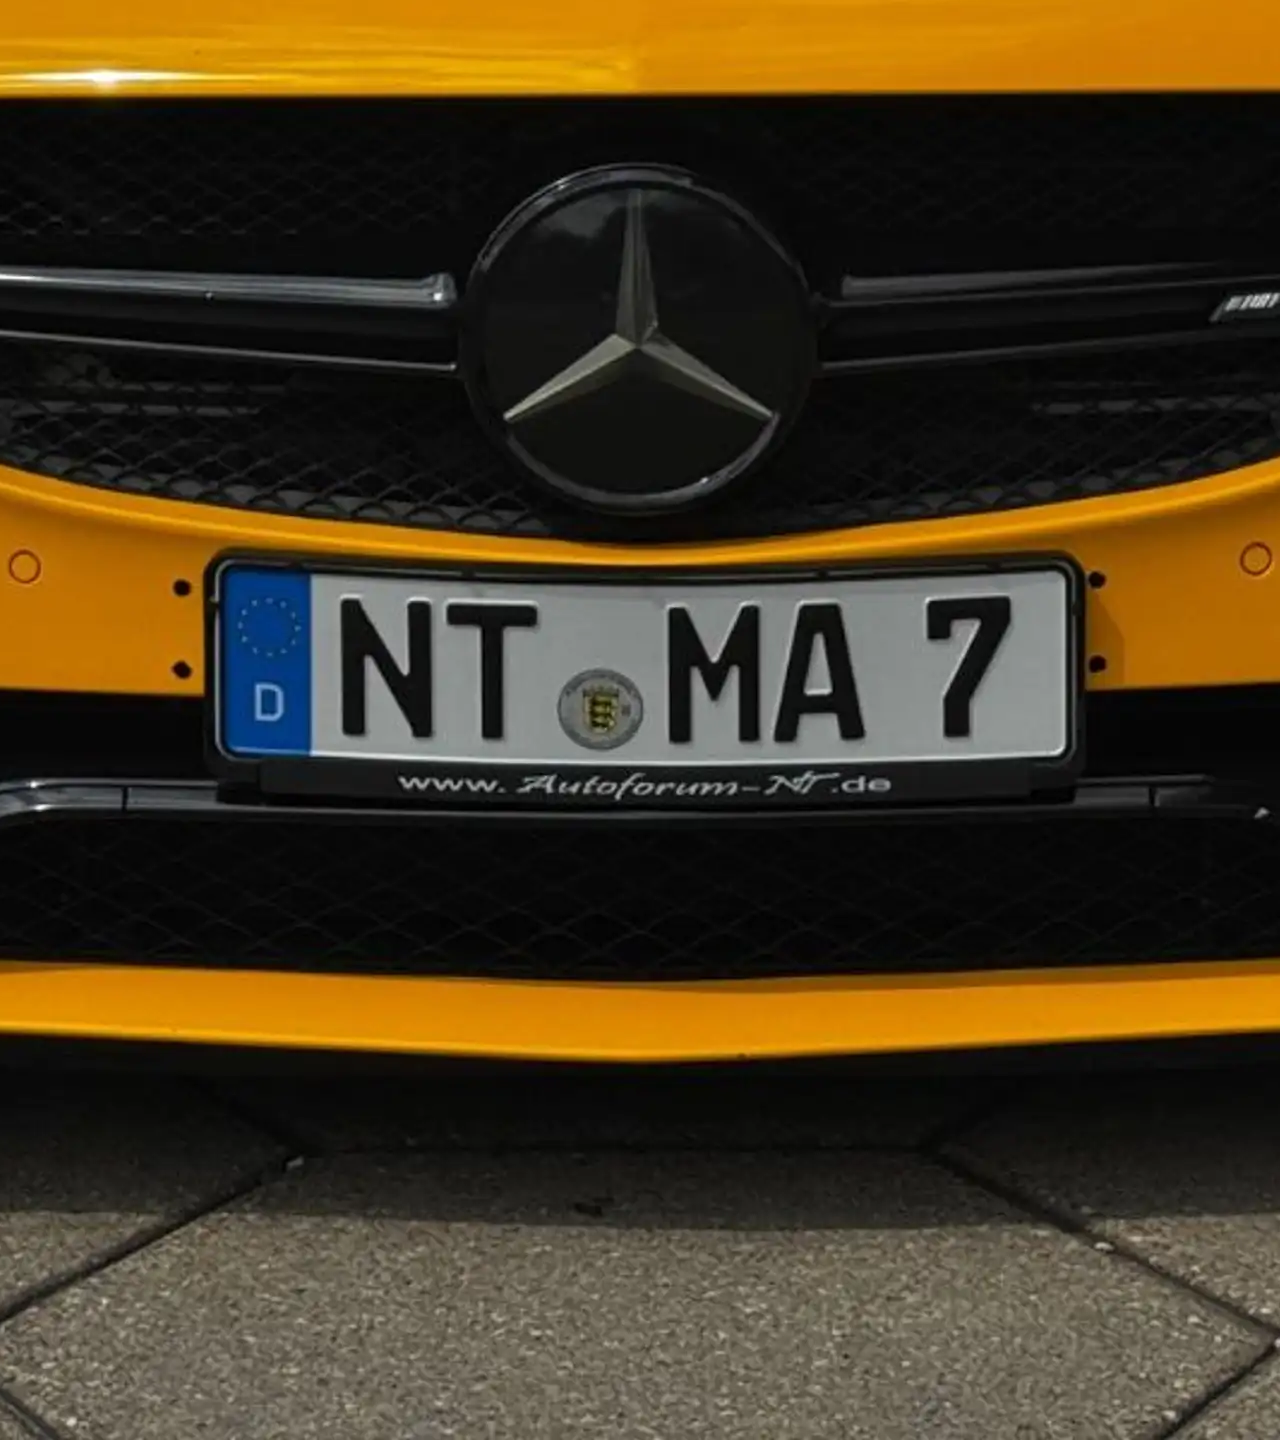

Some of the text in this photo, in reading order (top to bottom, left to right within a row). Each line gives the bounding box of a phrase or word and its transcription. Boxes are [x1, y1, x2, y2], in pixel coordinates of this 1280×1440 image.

[254, 682, 284, 722] D
[340, 594, 540, 740] NT
[667, 603, 866, 745] MA
[926, 595, 1012, 738] 7
